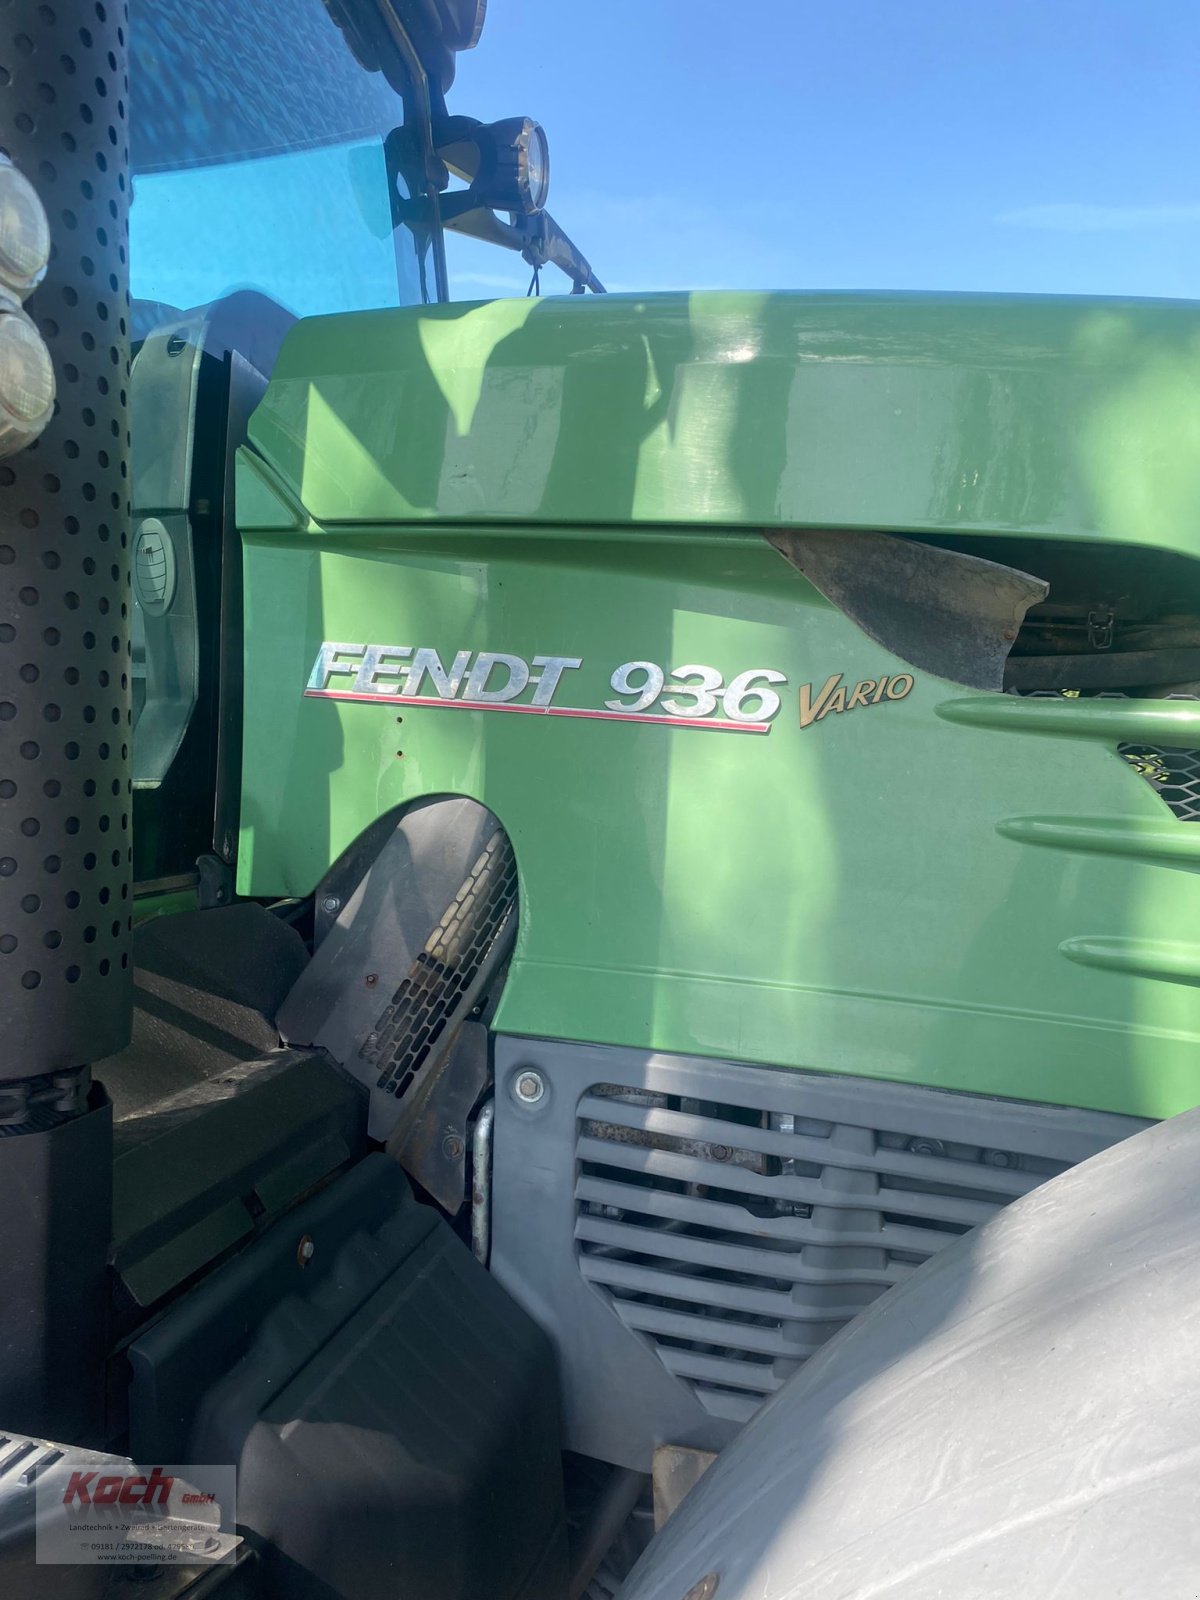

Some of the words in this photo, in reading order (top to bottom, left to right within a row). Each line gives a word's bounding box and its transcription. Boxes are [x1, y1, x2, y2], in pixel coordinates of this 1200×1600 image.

[306, 641, 583, 707] FENDT
[603, 660, 787, 724] 936
[799, 673, 915, 729] VARIO
